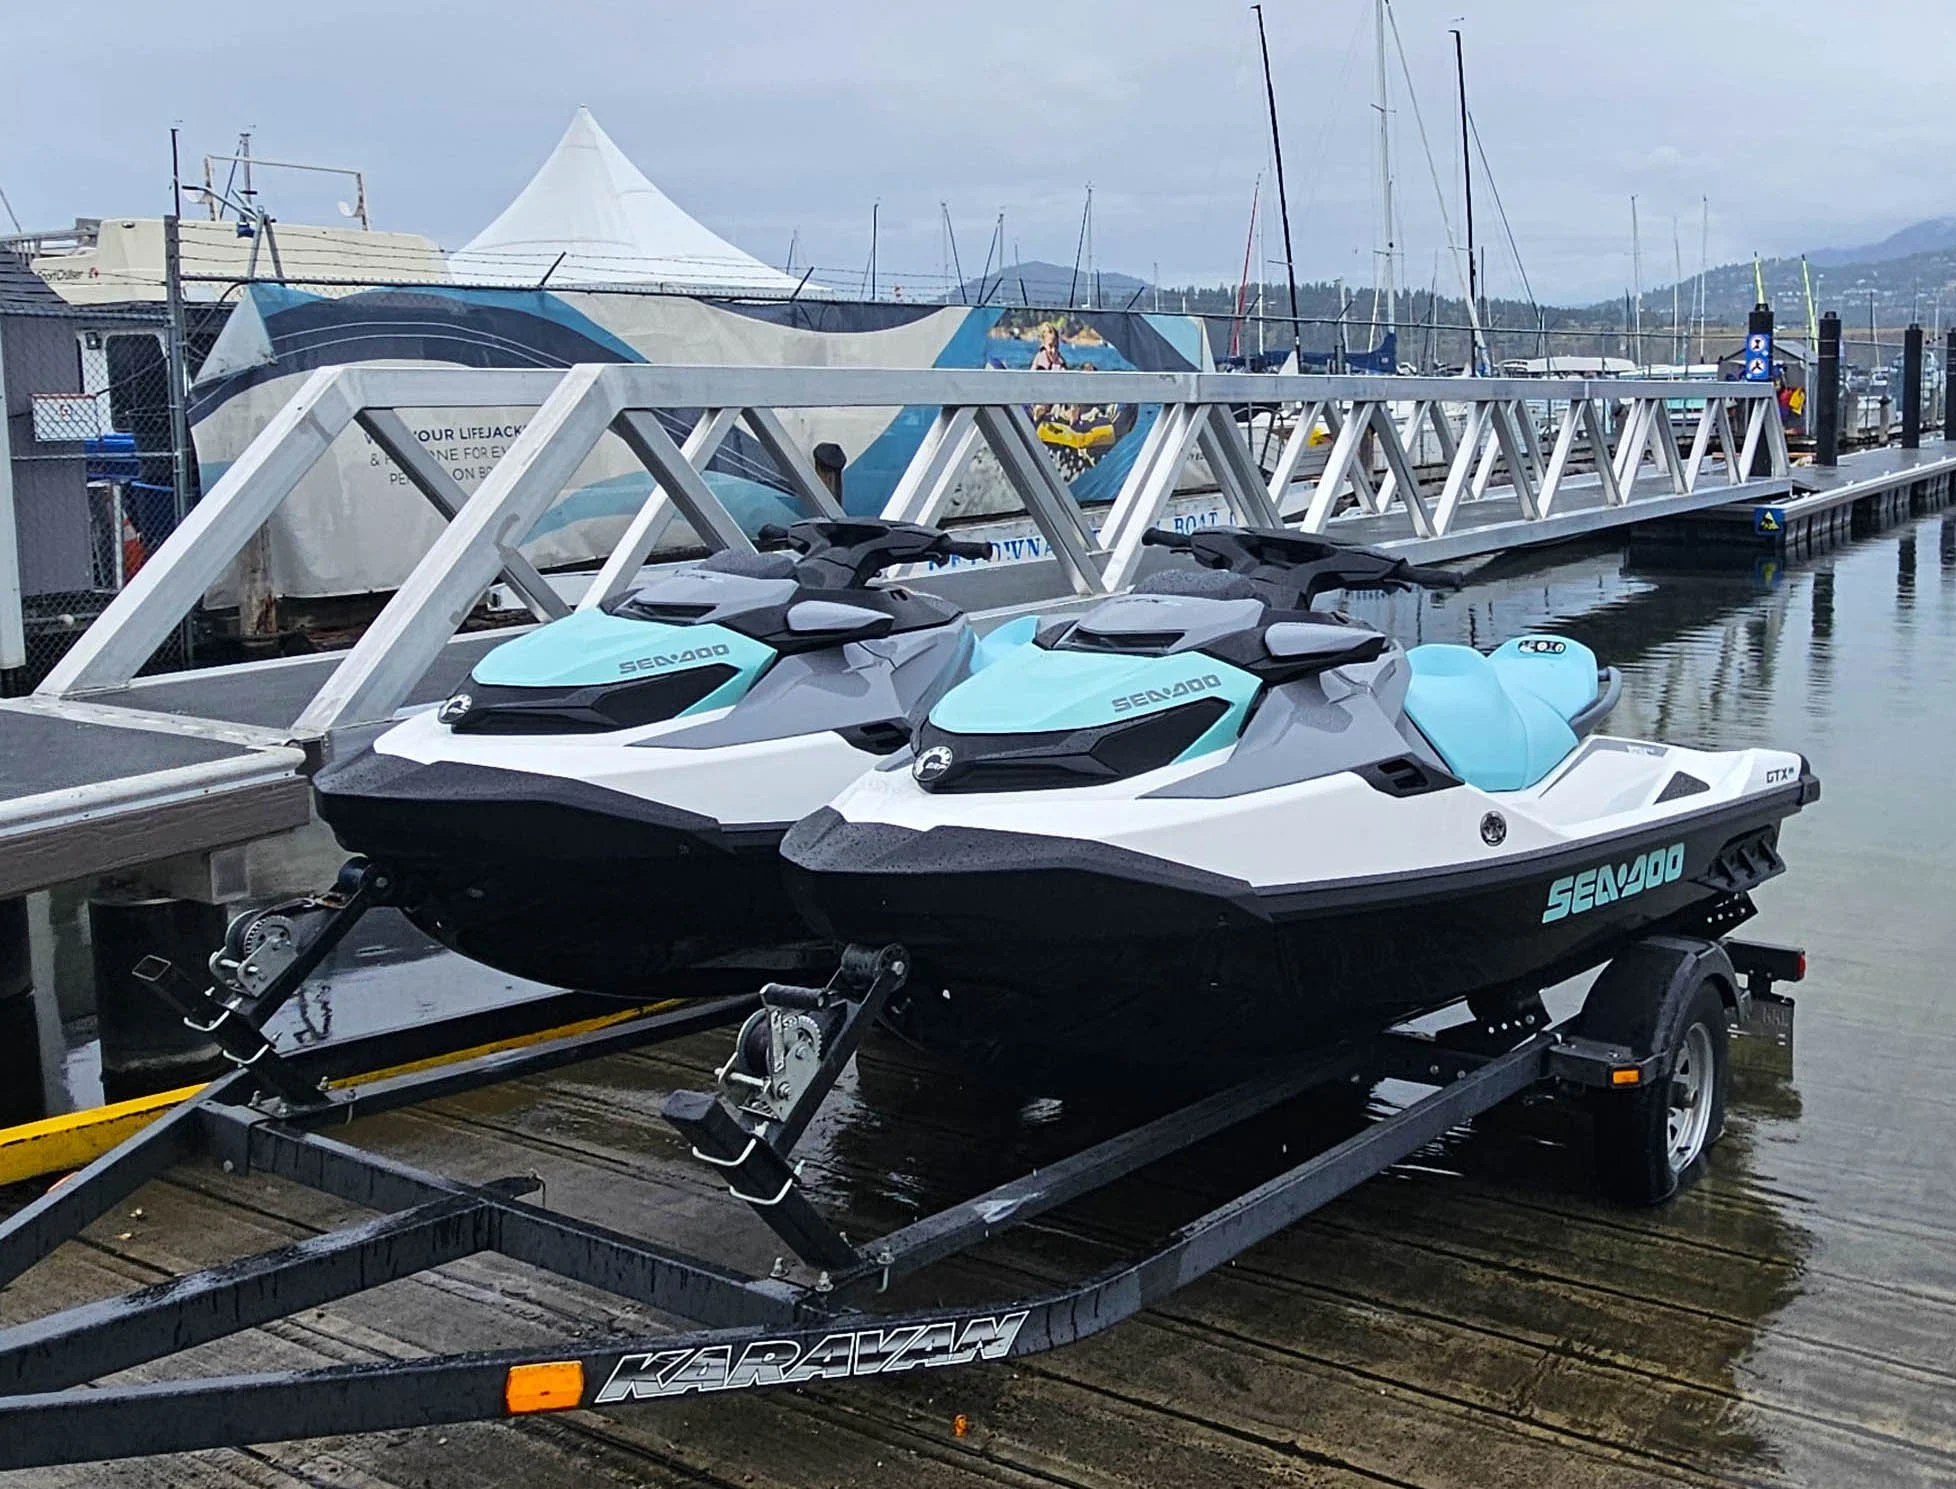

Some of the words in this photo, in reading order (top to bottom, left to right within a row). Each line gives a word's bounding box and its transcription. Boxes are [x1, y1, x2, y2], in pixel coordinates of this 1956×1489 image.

[413, 428, 455, 443] OUR
[459, 425, 527, 441] LIFEJACK
[430, 448, 460, 462] NE
[452, 468, 476, 481] ON
[595, 1310, 1031, 1404] KARAVAN
